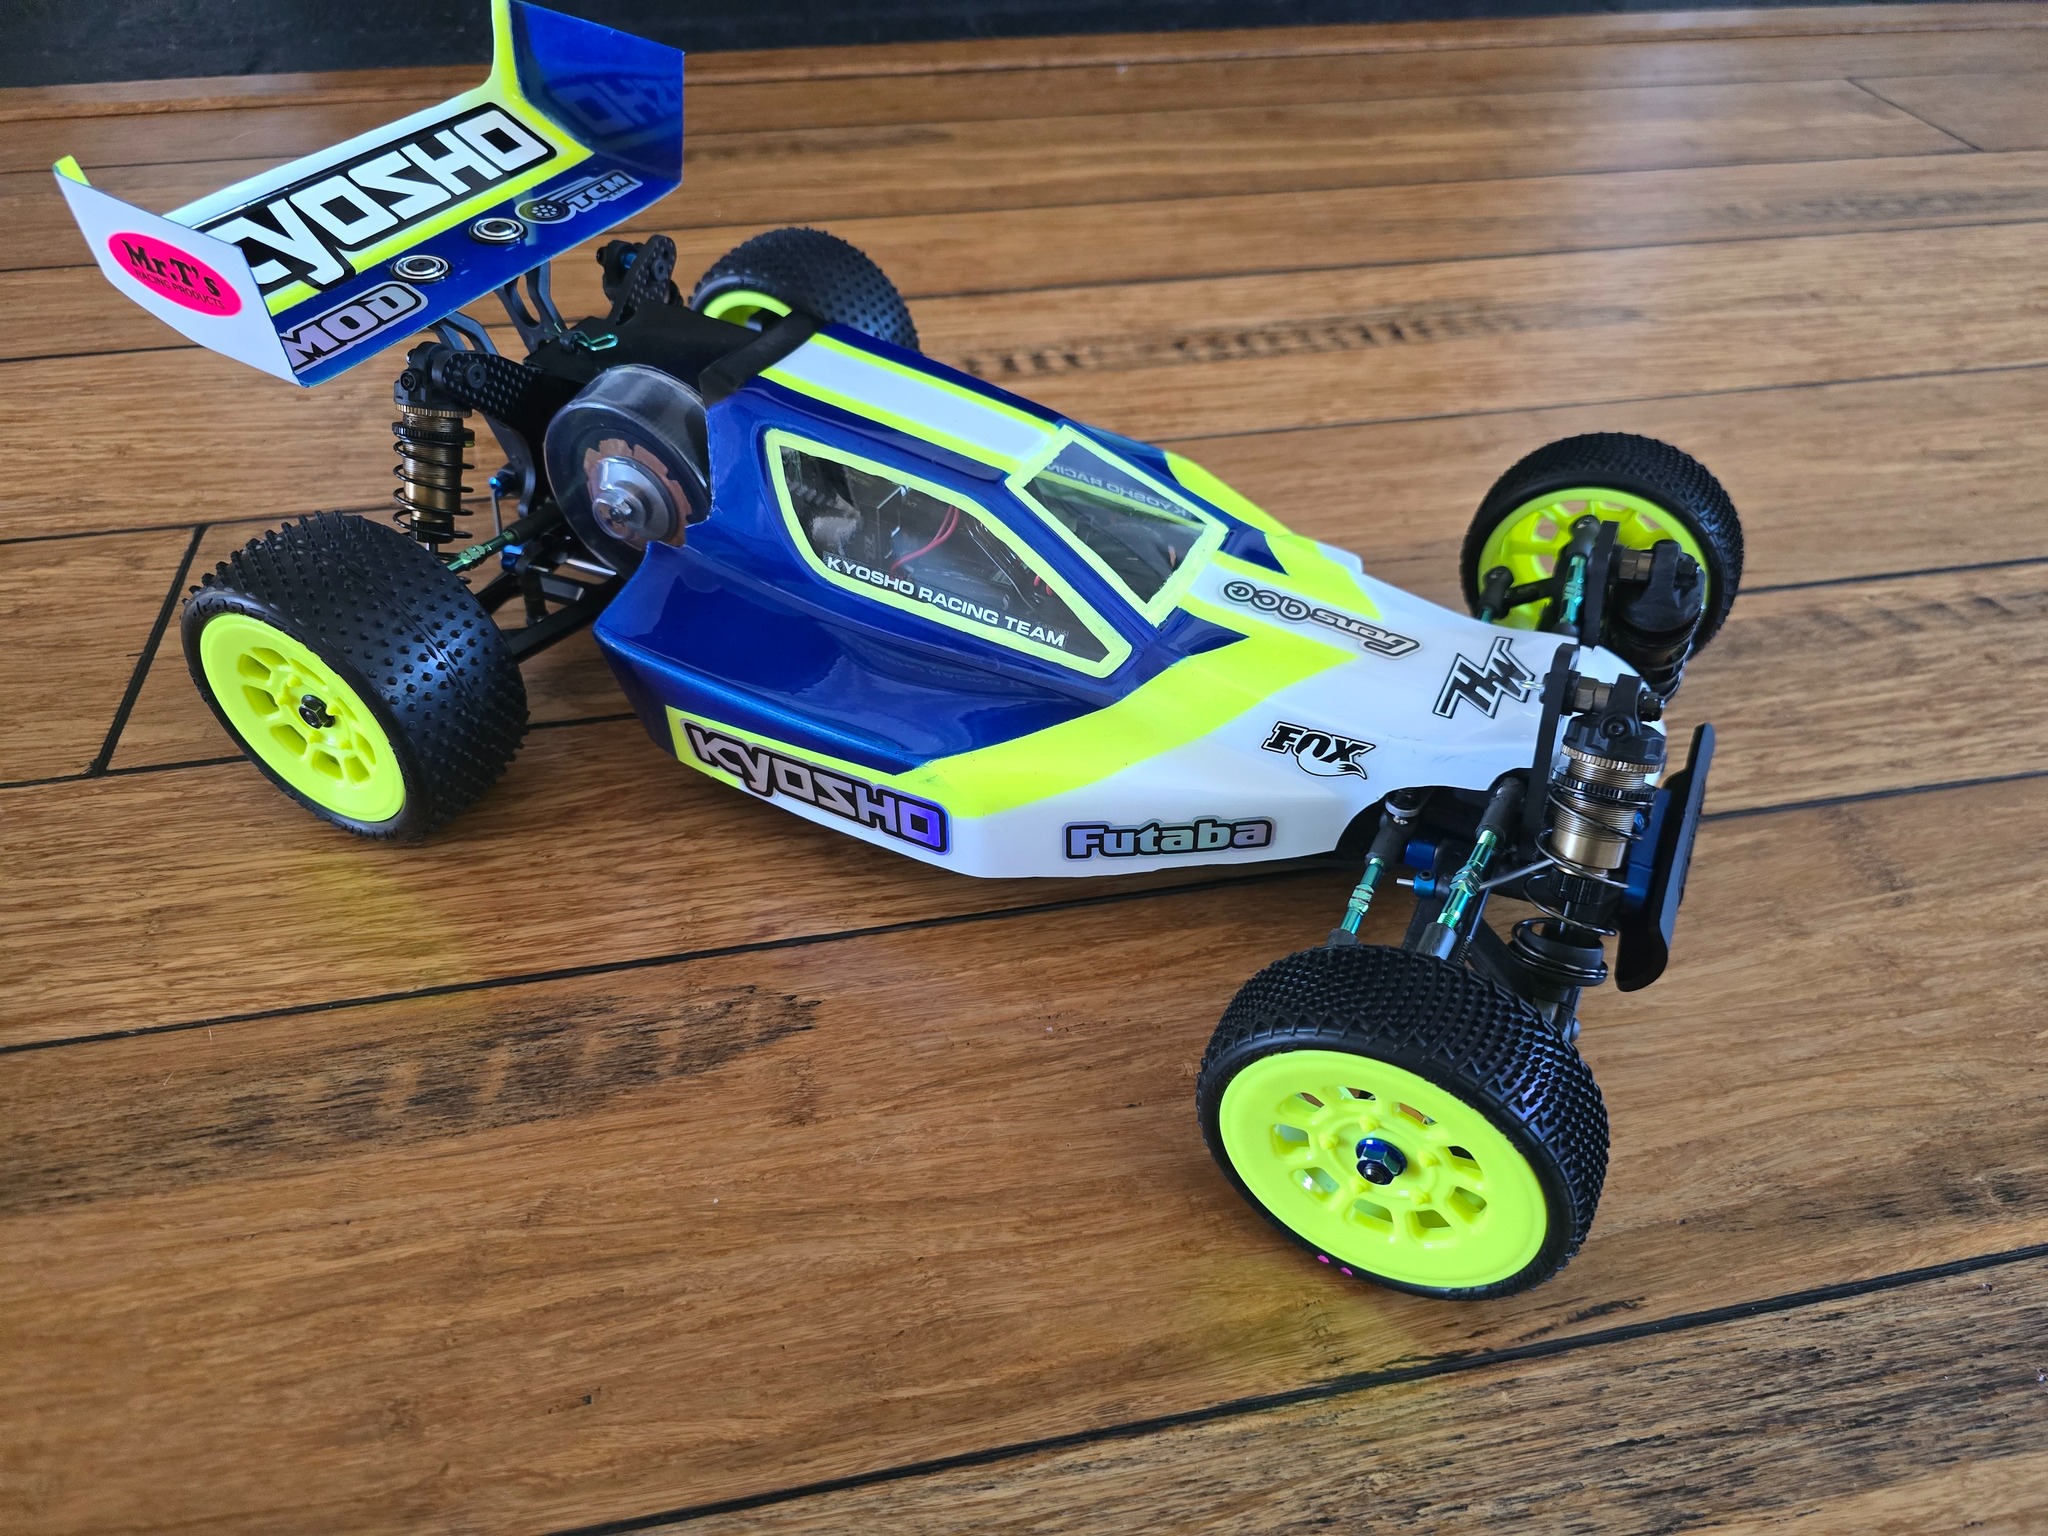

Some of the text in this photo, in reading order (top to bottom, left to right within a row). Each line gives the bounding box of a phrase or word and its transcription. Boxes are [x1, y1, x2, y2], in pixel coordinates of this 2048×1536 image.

[566, 174, 630, 208] TCM
[135, 269, 225, 310] RACING PRODUCTS
[827, 556, 1066, 648] KYOSHO RACING TEAM
[1262, 722, 1375, 770] FOX
[686, 724, 946, 851] KYOSHO
[1067, 820, 1271, 858] Futaba
